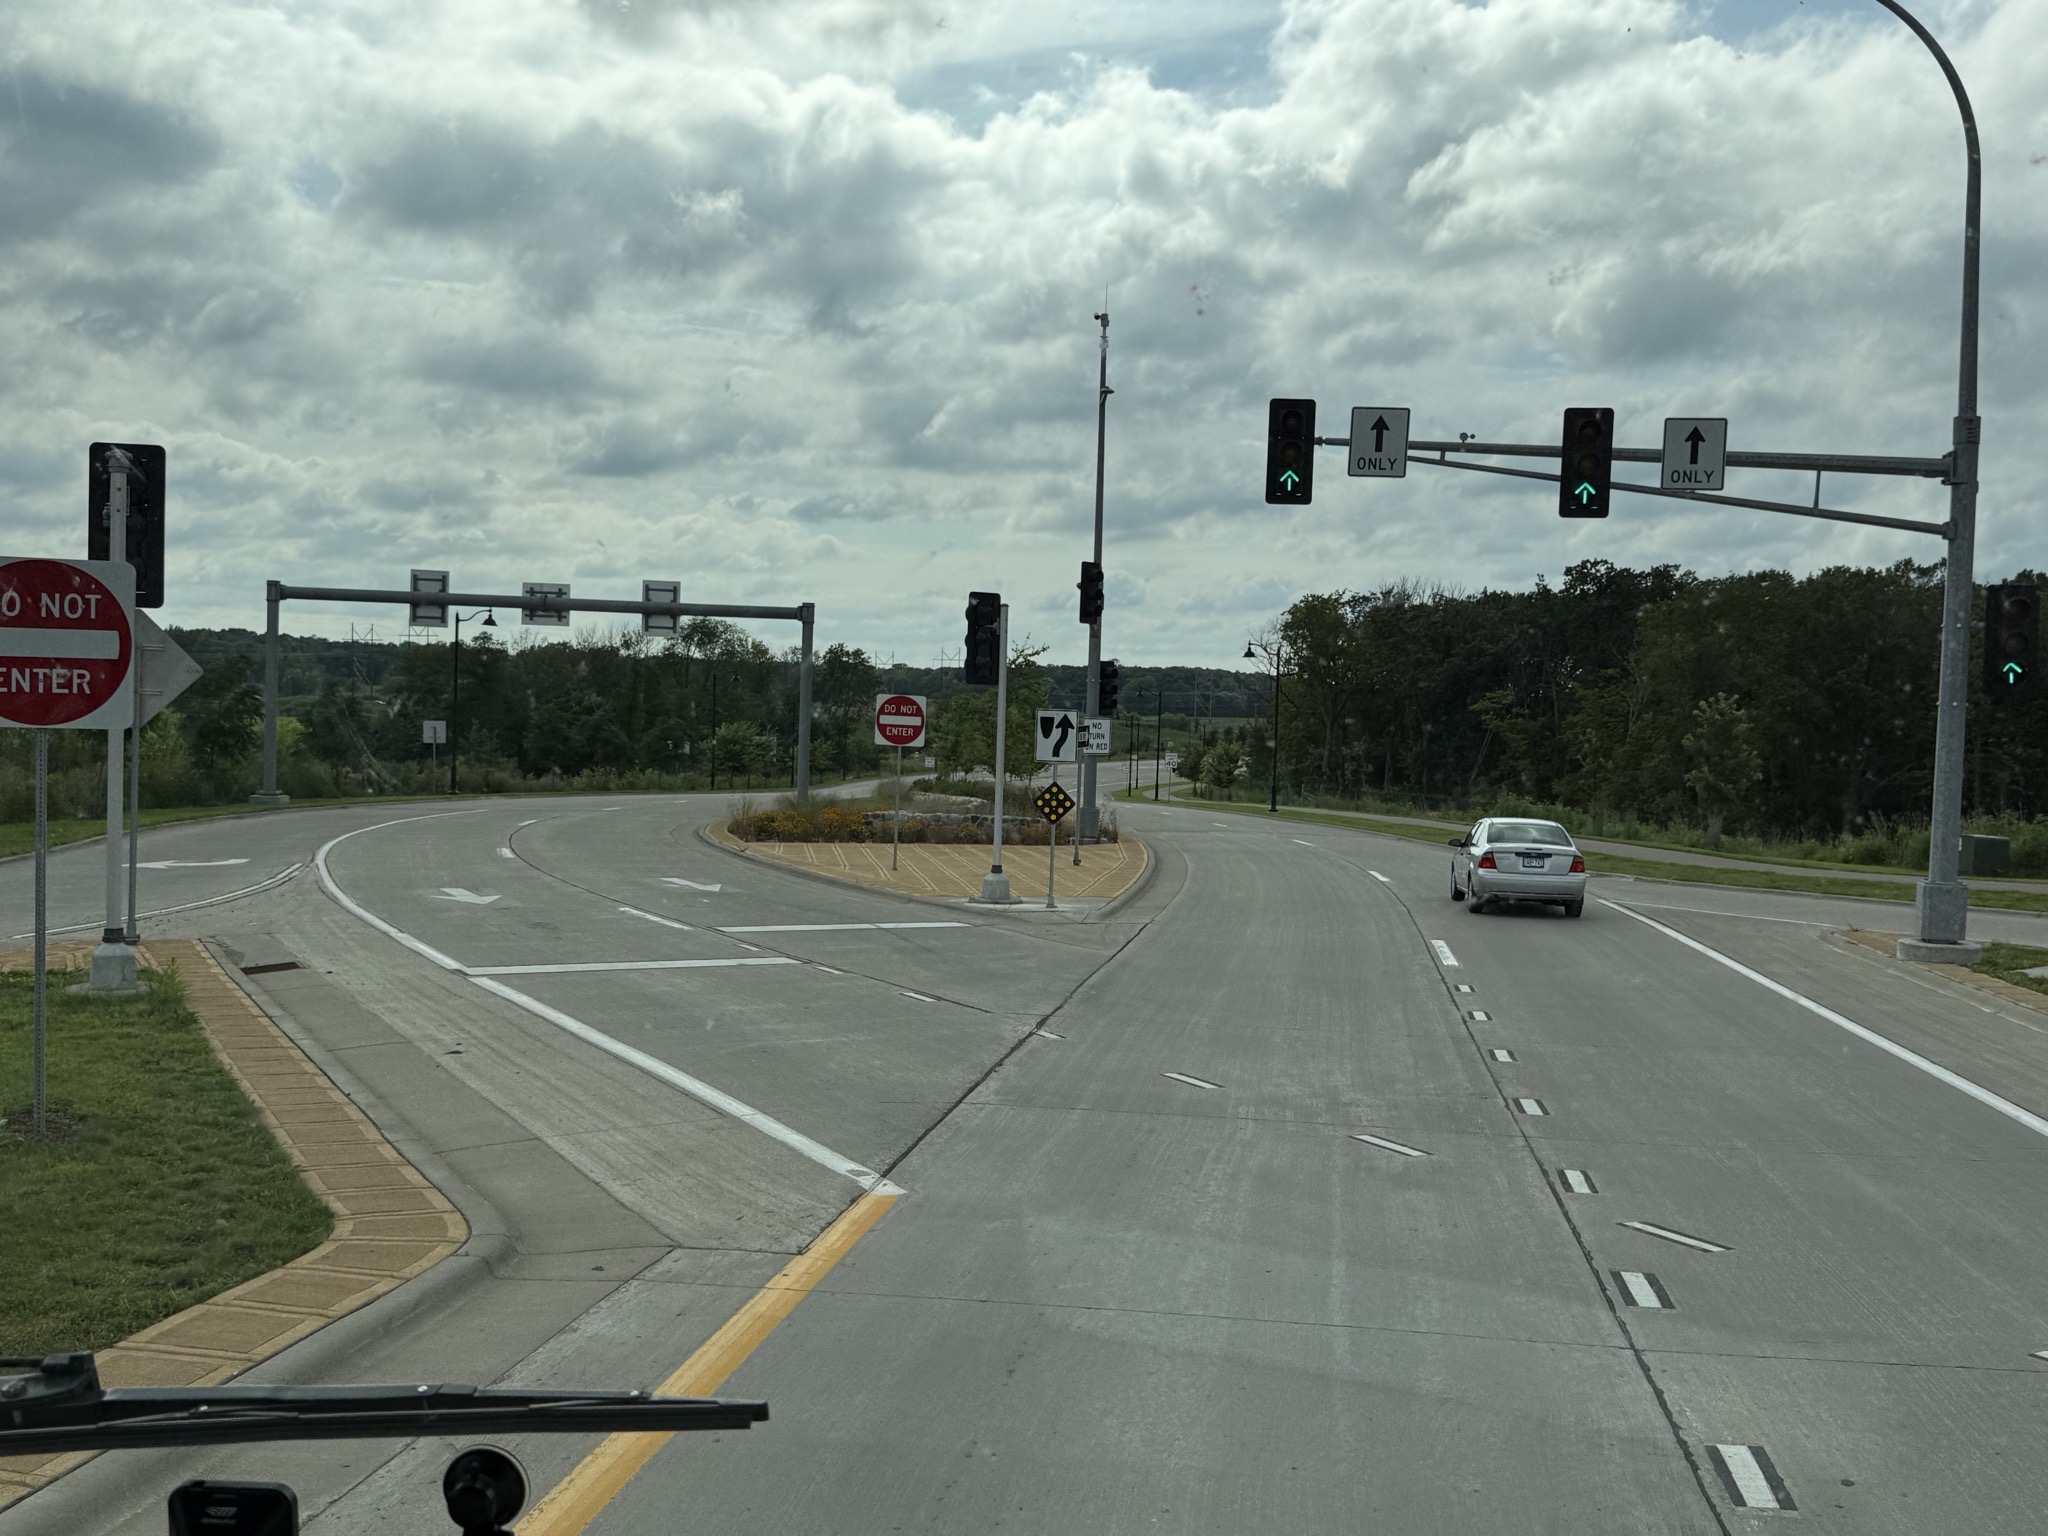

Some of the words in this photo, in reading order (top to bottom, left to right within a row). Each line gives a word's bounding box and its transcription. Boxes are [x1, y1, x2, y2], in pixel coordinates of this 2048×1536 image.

[1357, 457, 1397, 471] ONLY
[1671, 470, 1715, 484] ONLY
[0, 590, 21, 617] O
[41, 592, 102, 620] NOT
[884, 704, 896, 713] DO
[900, 705, 917, 714] NOT
[1092, 722, 1102, 730] NO
[886, 727, 914, 737] ENTER
[1088, 732, 1105, 740] TURN
[1096, 743, 1108, 751] RED
